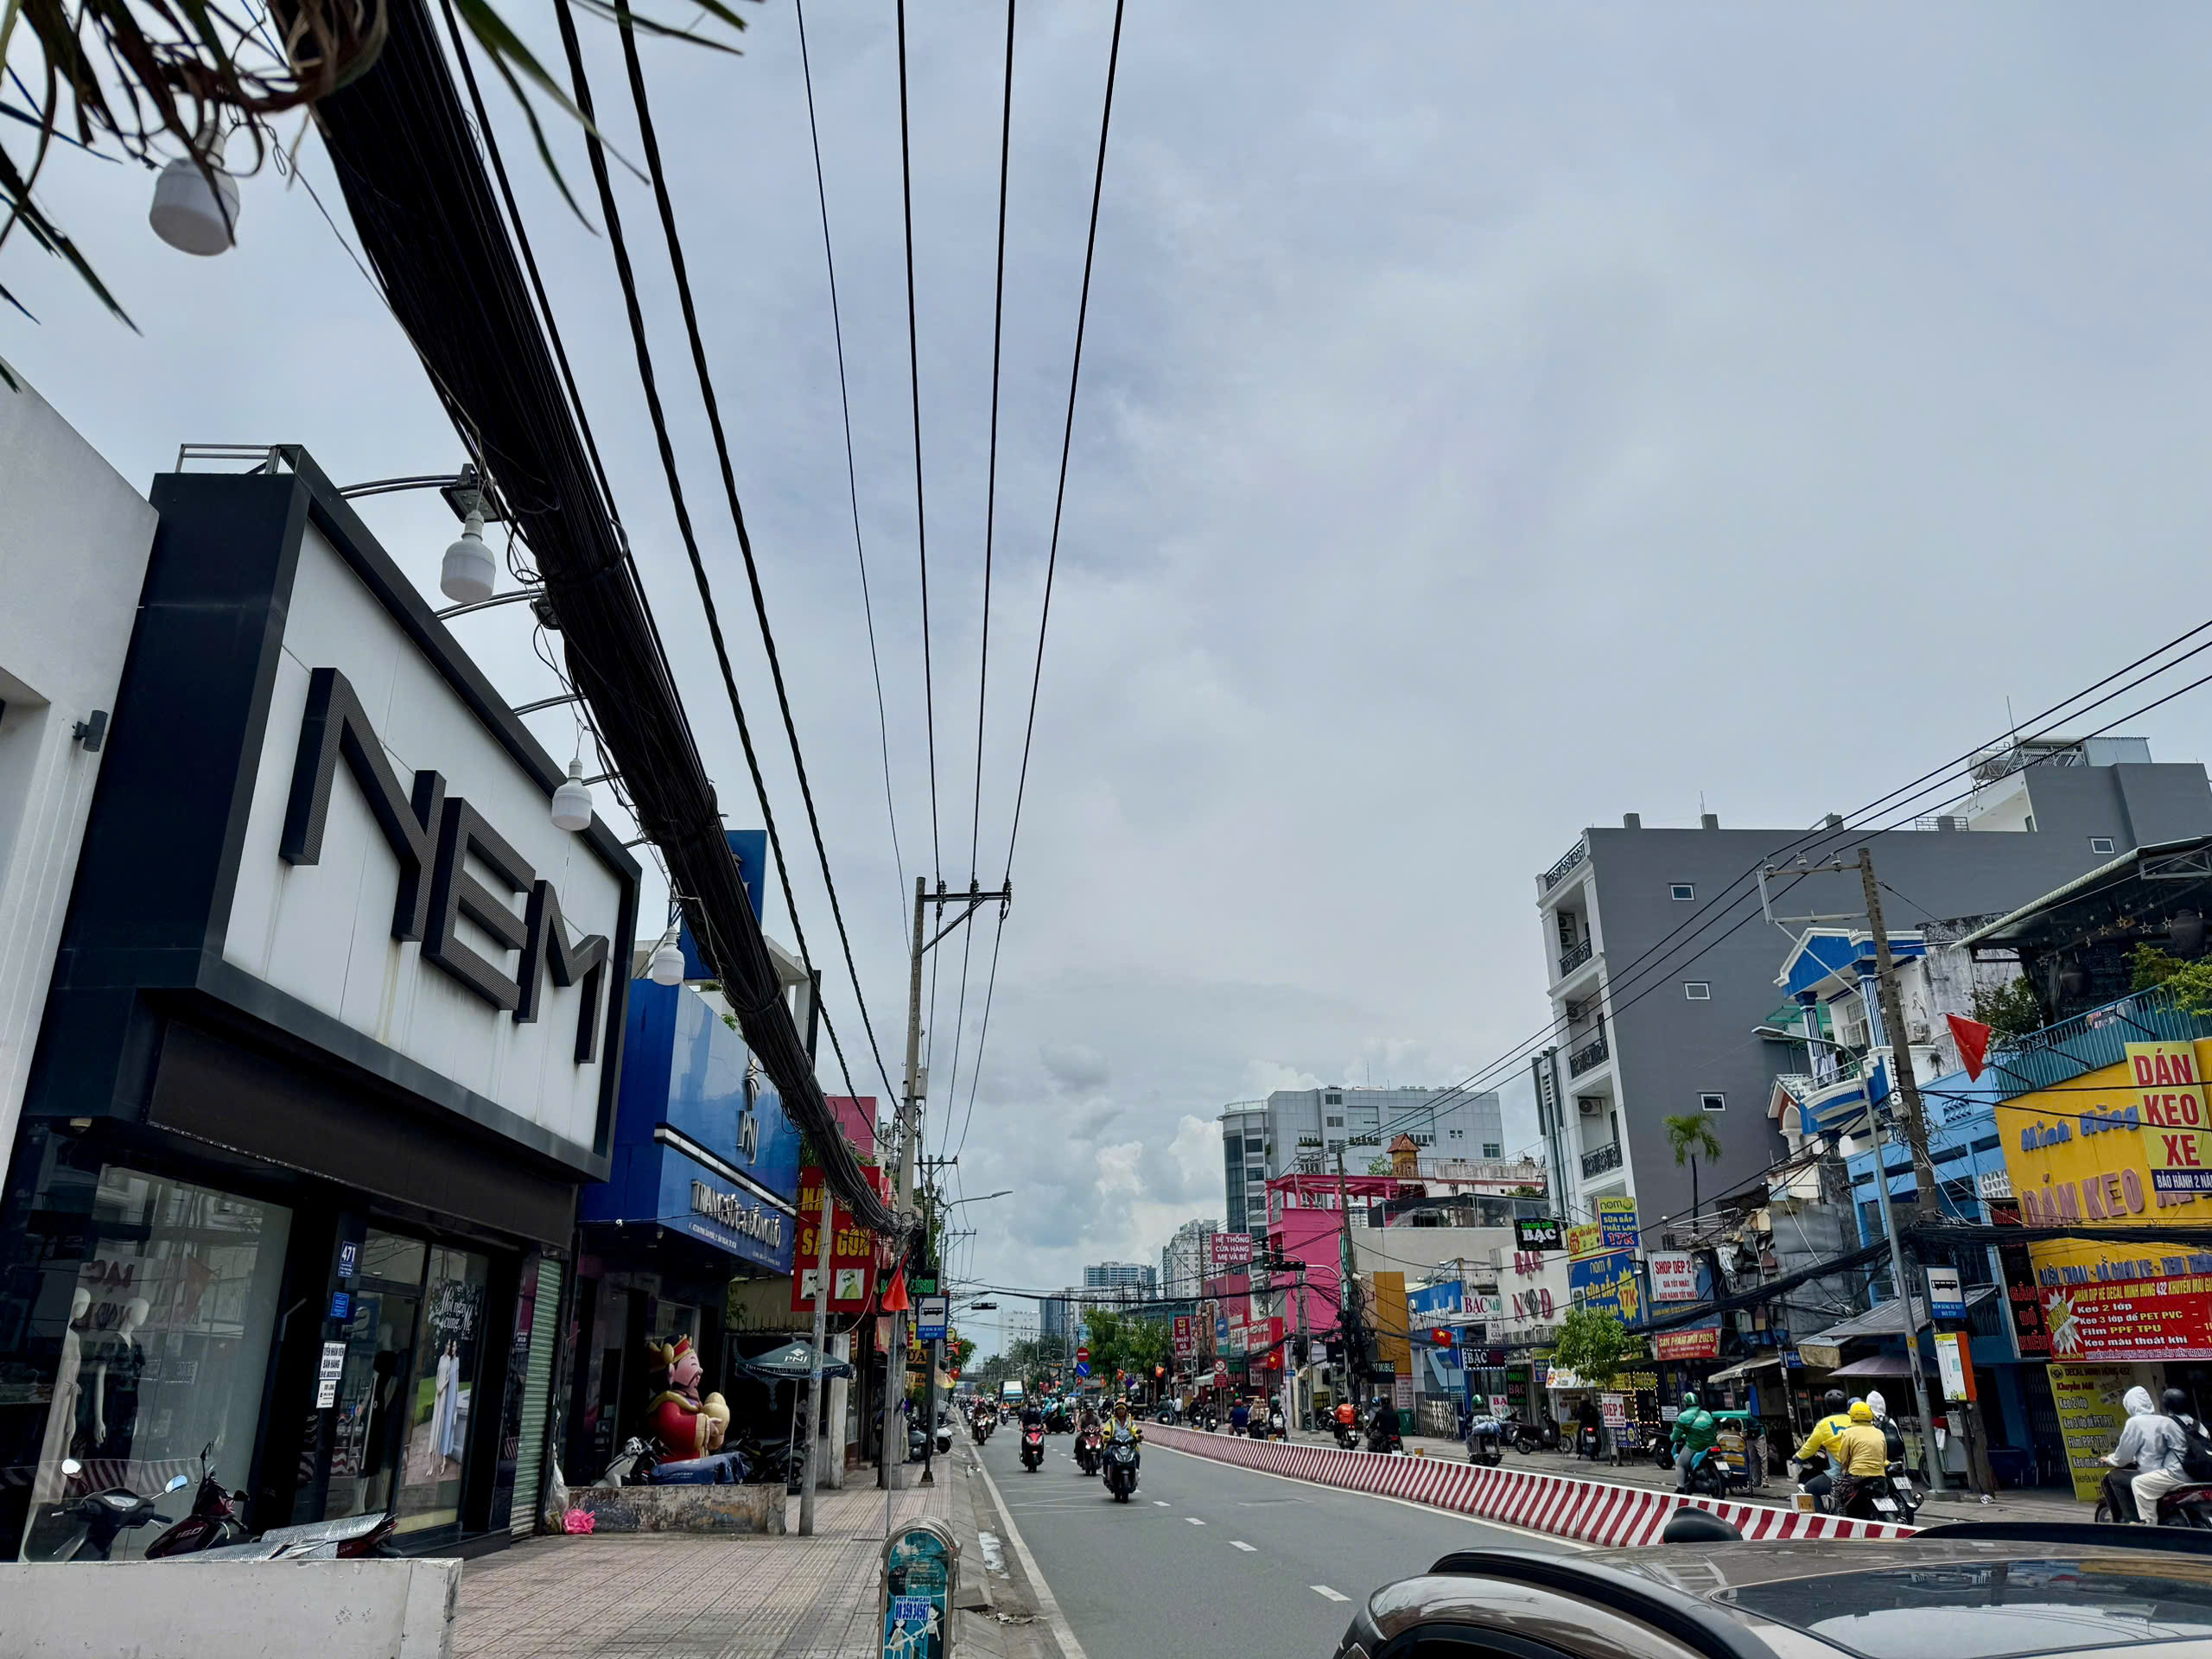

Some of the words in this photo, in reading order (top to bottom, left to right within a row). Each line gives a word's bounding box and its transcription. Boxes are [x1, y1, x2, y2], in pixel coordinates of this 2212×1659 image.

[278, 667, 609, 1065] NEM
[2133, 1048, 2193, 1085] DÁN
[2143, 1094, 2200, 1126] KEO
[2021, 1120, 2072, 1151] Minh
[2161, 1135, 2201, 1166] XE
[2157, 1170, 2171, 1188] BẢO
[2173, 1171, 2194, 1188] HÀNH
[2195, 1176, 2201, 1188] 2
[2201, 1172, 2212, 1189] NĂ
[2022, 1173, 2082, 1228] DÁN
[2082, 1168, 2145, 1220] KEO
[1600, 1200, 1623, 1211] nom
[1215, 1236, 1224, 1244] HỆ
[1226, 1234, 1249, 1243] THỐNG
[1522, 1229, 1556, 1243] BẠC
[1608, 1233, 1635, 1245] 17K
[341, 1245, 356, 1262] 471
[1215, 1243, 1230, 1252] CỬA
[1229, 1252, 1238, 1261] VÀ
[1239, 1252, 1247, 1261] BÉ
[1514, 1251, 1543, 1281] BẠC
[1655, 1261, 1672, 1274] SHOP
[1687, 1261, 1692, 1274] 2
[2107, 1286, 2123, 1300] DECAL
[2157, 1281, 2167, 1296] 432
[2168, 1275, 2191, 1294] KHUYẾN
[1619, 1289, 1637, 1308] 17K
[1465, 1297, 1487, 1315] BẠC
[2113, 1302, 2133, 1311] lớp
[2108, 1314, 2123, 1323] lớp
[2139, 1312, 2158, 1320] PET
[2161, 1311, 2183, 1319] PVC
[2082, 1327, 2107, 1336] Film
[2109, 1325, 2133, 1334] PPF
[2136, 1324, 2162, 1333] TPU
[1699, 1332, 1714, 1344] 2026
[2107, 1337, 2133, 1346] màu
[2134, 1336, 2165, 1345] thoát
[2168, 1335, 2188, 1344] khí
[1467, 1352, 1488, 1367] BẠC
[1378, 1363, 1395, 1372] MOBILE
[1508, 1371, 1525, 1381] INOX
[1493, 1396, 1507, 1408] BẠ
[1618, 1404, 1624, 1416] 2
[175, 1526, 204, 1540] 160
